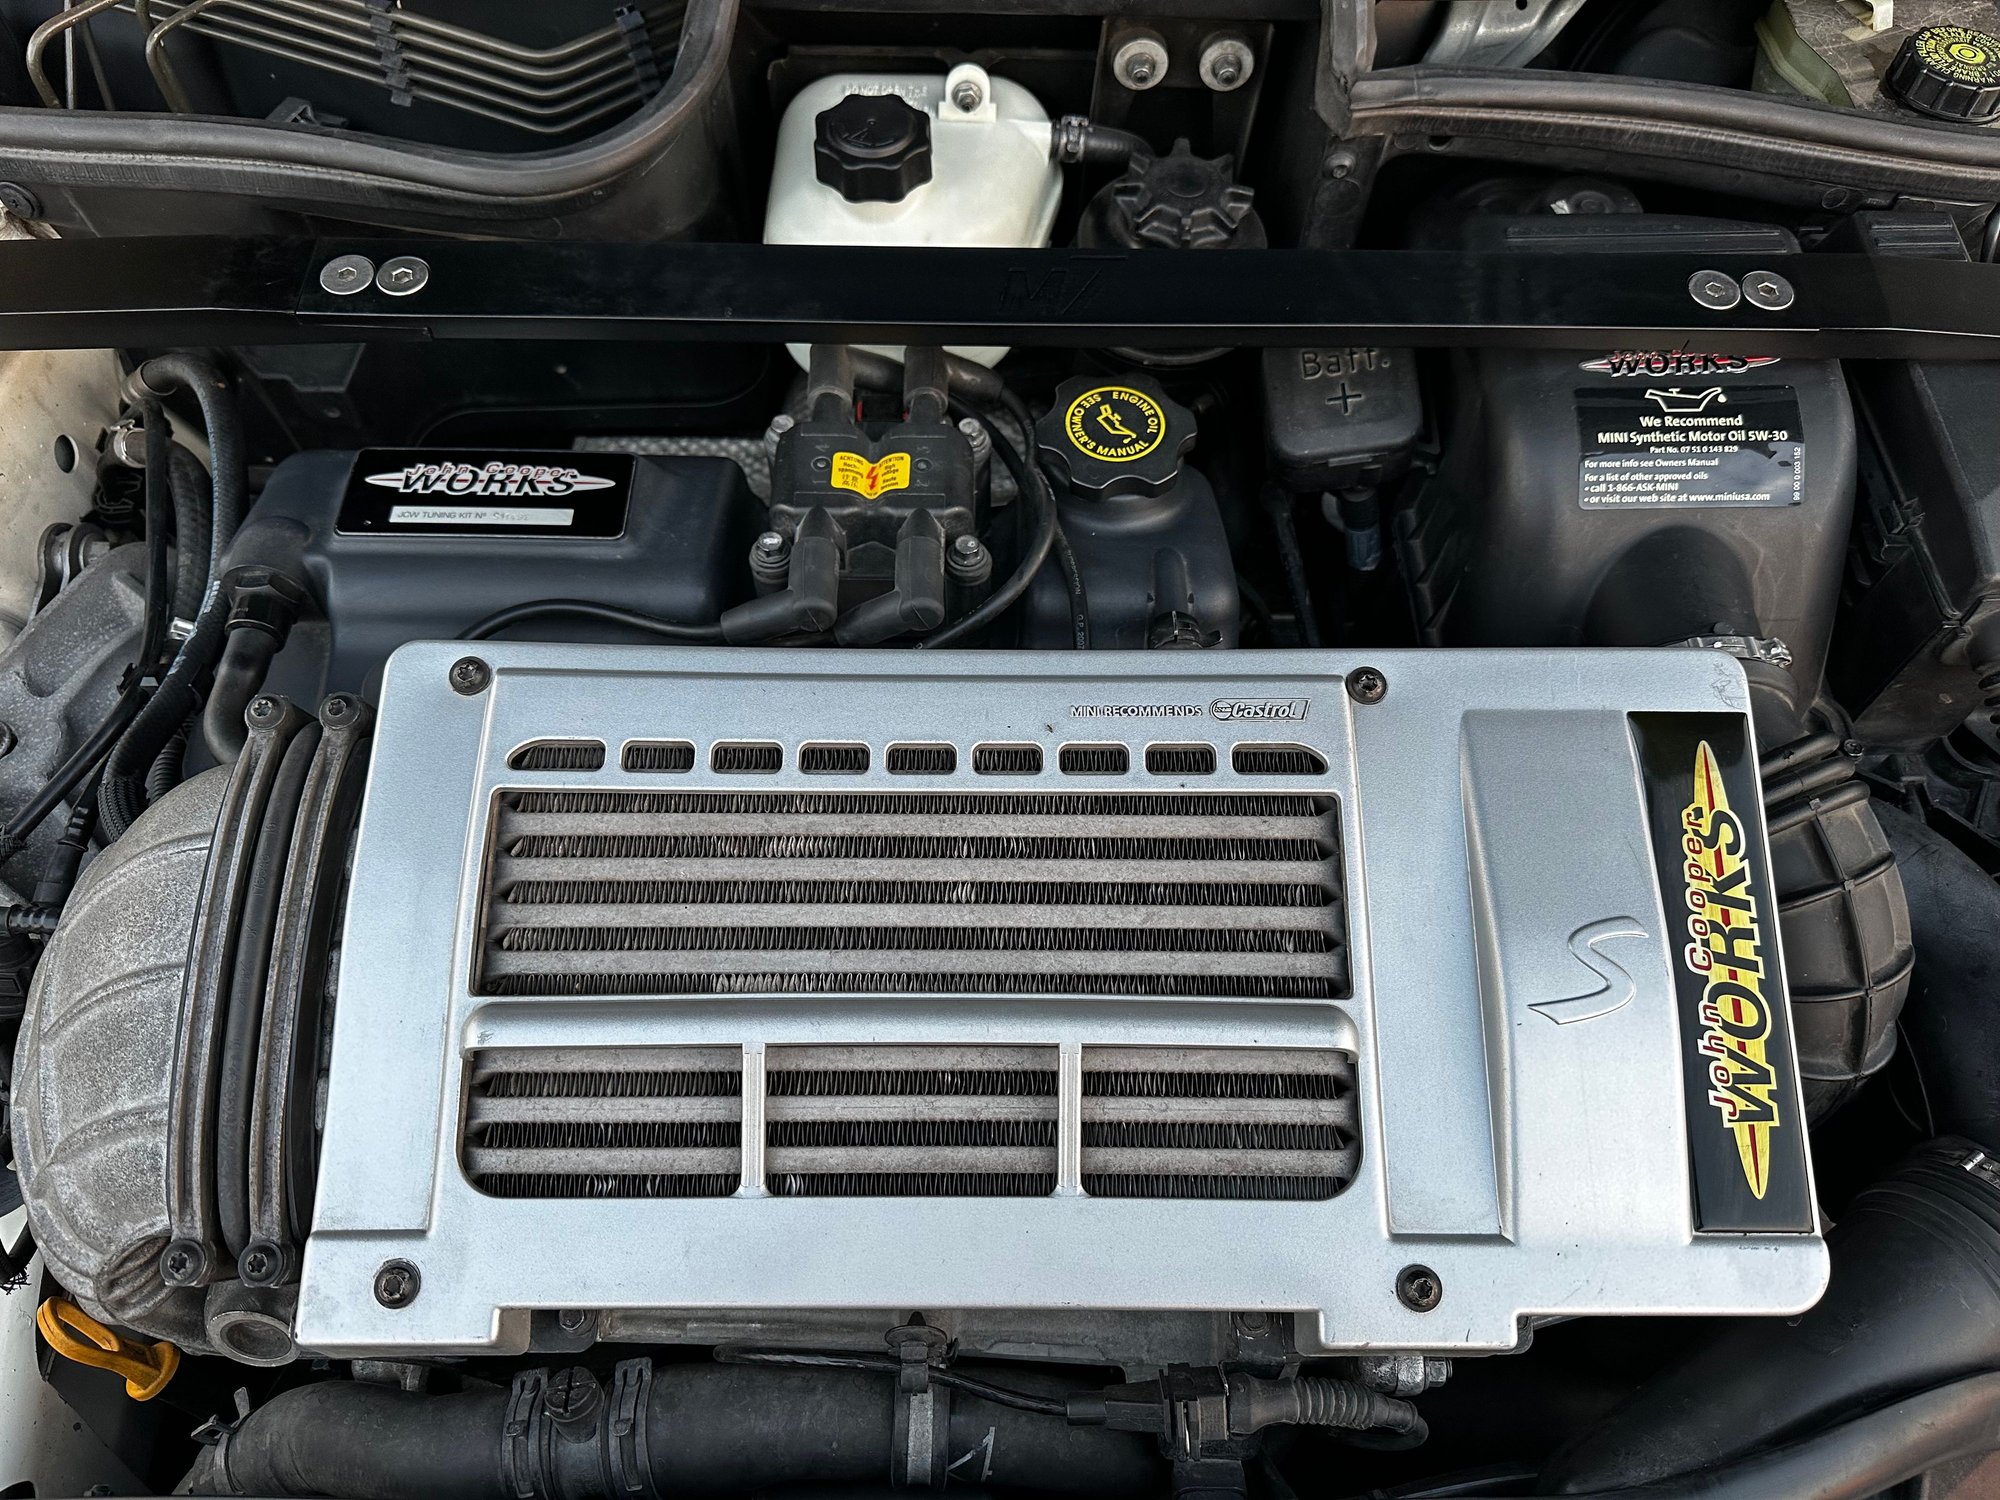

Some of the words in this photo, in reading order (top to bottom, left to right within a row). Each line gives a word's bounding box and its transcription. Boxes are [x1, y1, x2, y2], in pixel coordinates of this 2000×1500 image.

[1948, 65, 1982, 77] BRAKE
[1953, 72, 1996, 84] WARNING
[1608, 352, 1750, 377] WORKS
[1080, 393, 1102, 409] SEE
[1112, 391, 1155, 417] ENGINE
[1146, 417, 1159, 434] OIL
[1639, 415, 1662, 427] We
[1664, 414, 1743, 427] Recommend
[1071, 408, 1097, 450] OWNER'S
[1597, 432, 1629, 444] MINI
[1630, 431, 1687, 446] Synthetic
[1688, 431, 1726, 442] Motor
[1727, 430, 1746, 441] Oil
[1748, 431, 1788, 441] 5W-30
[1096, 440, 1149, 457] MANUAL
[1649, 446, 1665, 454] Part
[1666, 446, 1679, 454] No.
[407, 462, 472, 477] John
[484, 461, 578, 479] Cooper
[1584, 460, 1598, 468] For
[1622, 459, 1639, 468] info
[1655, 459, 1687, 467] Owners
[1688, 458, 1719, 466] Manual
[399, 467, 575, 496] WORKS
[1584, 473, 1599, 482] For
[1606, 473, 1619, 481] list
[1620, 472, 1630, 481] of
[1630, 472, 1653, 481] other
[1653, 471, 1693, 482] approved
[1693, 471, 1709, 480] oils
[1590, 483, 1607, 493] call
[1607, 483, 1680, 492] 1-866-ASK-MINI
[1589, 496, 1601, 504] or
[1601, 494, 1621, 503] visit
[1621, 495, 1638, 503] our
[1638, 493, 1659, 502] web
[1660, 493, 1677, 502] site
[1677, 494, 1688, 502] at
[1689, 492, 1771, 502] www.miniusa.com
[397, 511, 420, 519] JCW
[423, 511, 457, 519] TUNING
[1070, 704, 1101, 717] MINI
[1102, 704, 1202, 717] RECOMMENDS
[1232, 700, 1297, 719] Castrol
[1681, 803, 1716, 975] Cooper
[1527, 915, 1649, 1025] S
[1702, 808, 1780, 1128] WORKS
[1697, 999, 1738, 1119] John
